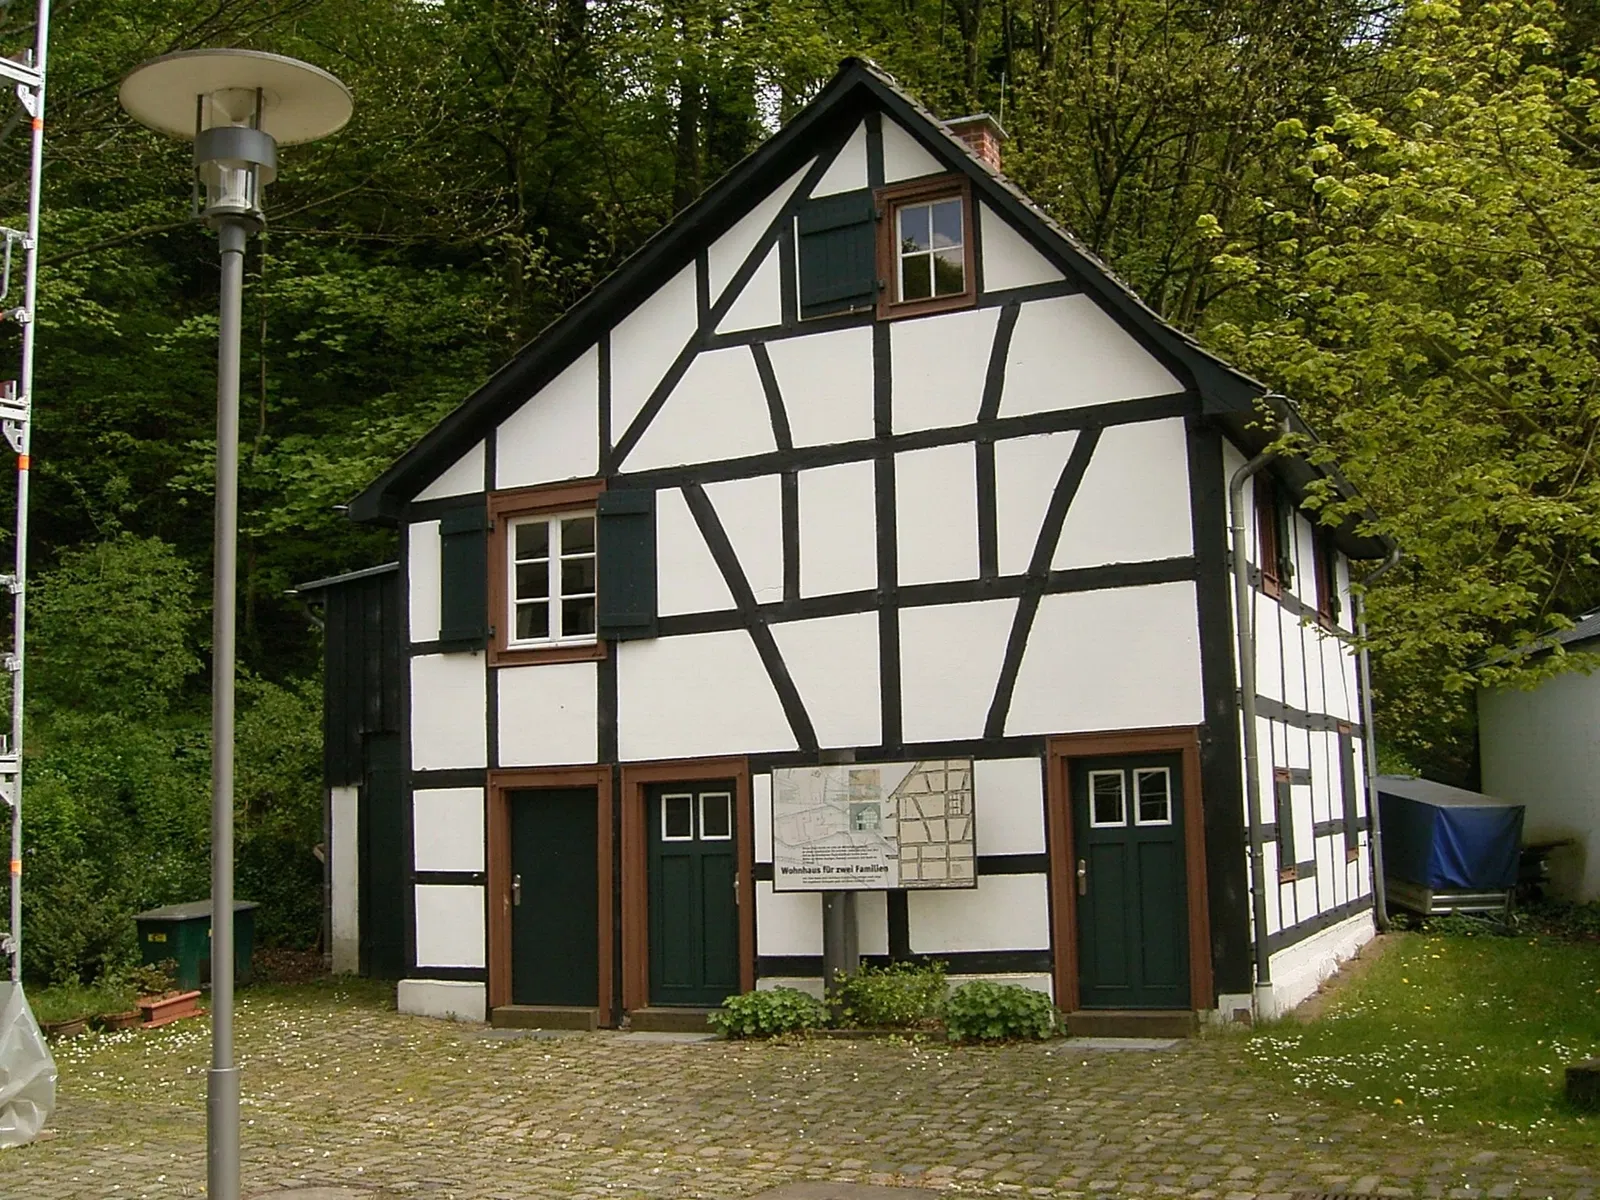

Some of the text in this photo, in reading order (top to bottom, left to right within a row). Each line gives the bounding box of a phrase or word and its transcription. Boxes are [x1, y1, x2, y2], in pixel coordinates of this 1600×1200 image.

[781, 864, 889, 875] Wohnhaus für zwei Familien
